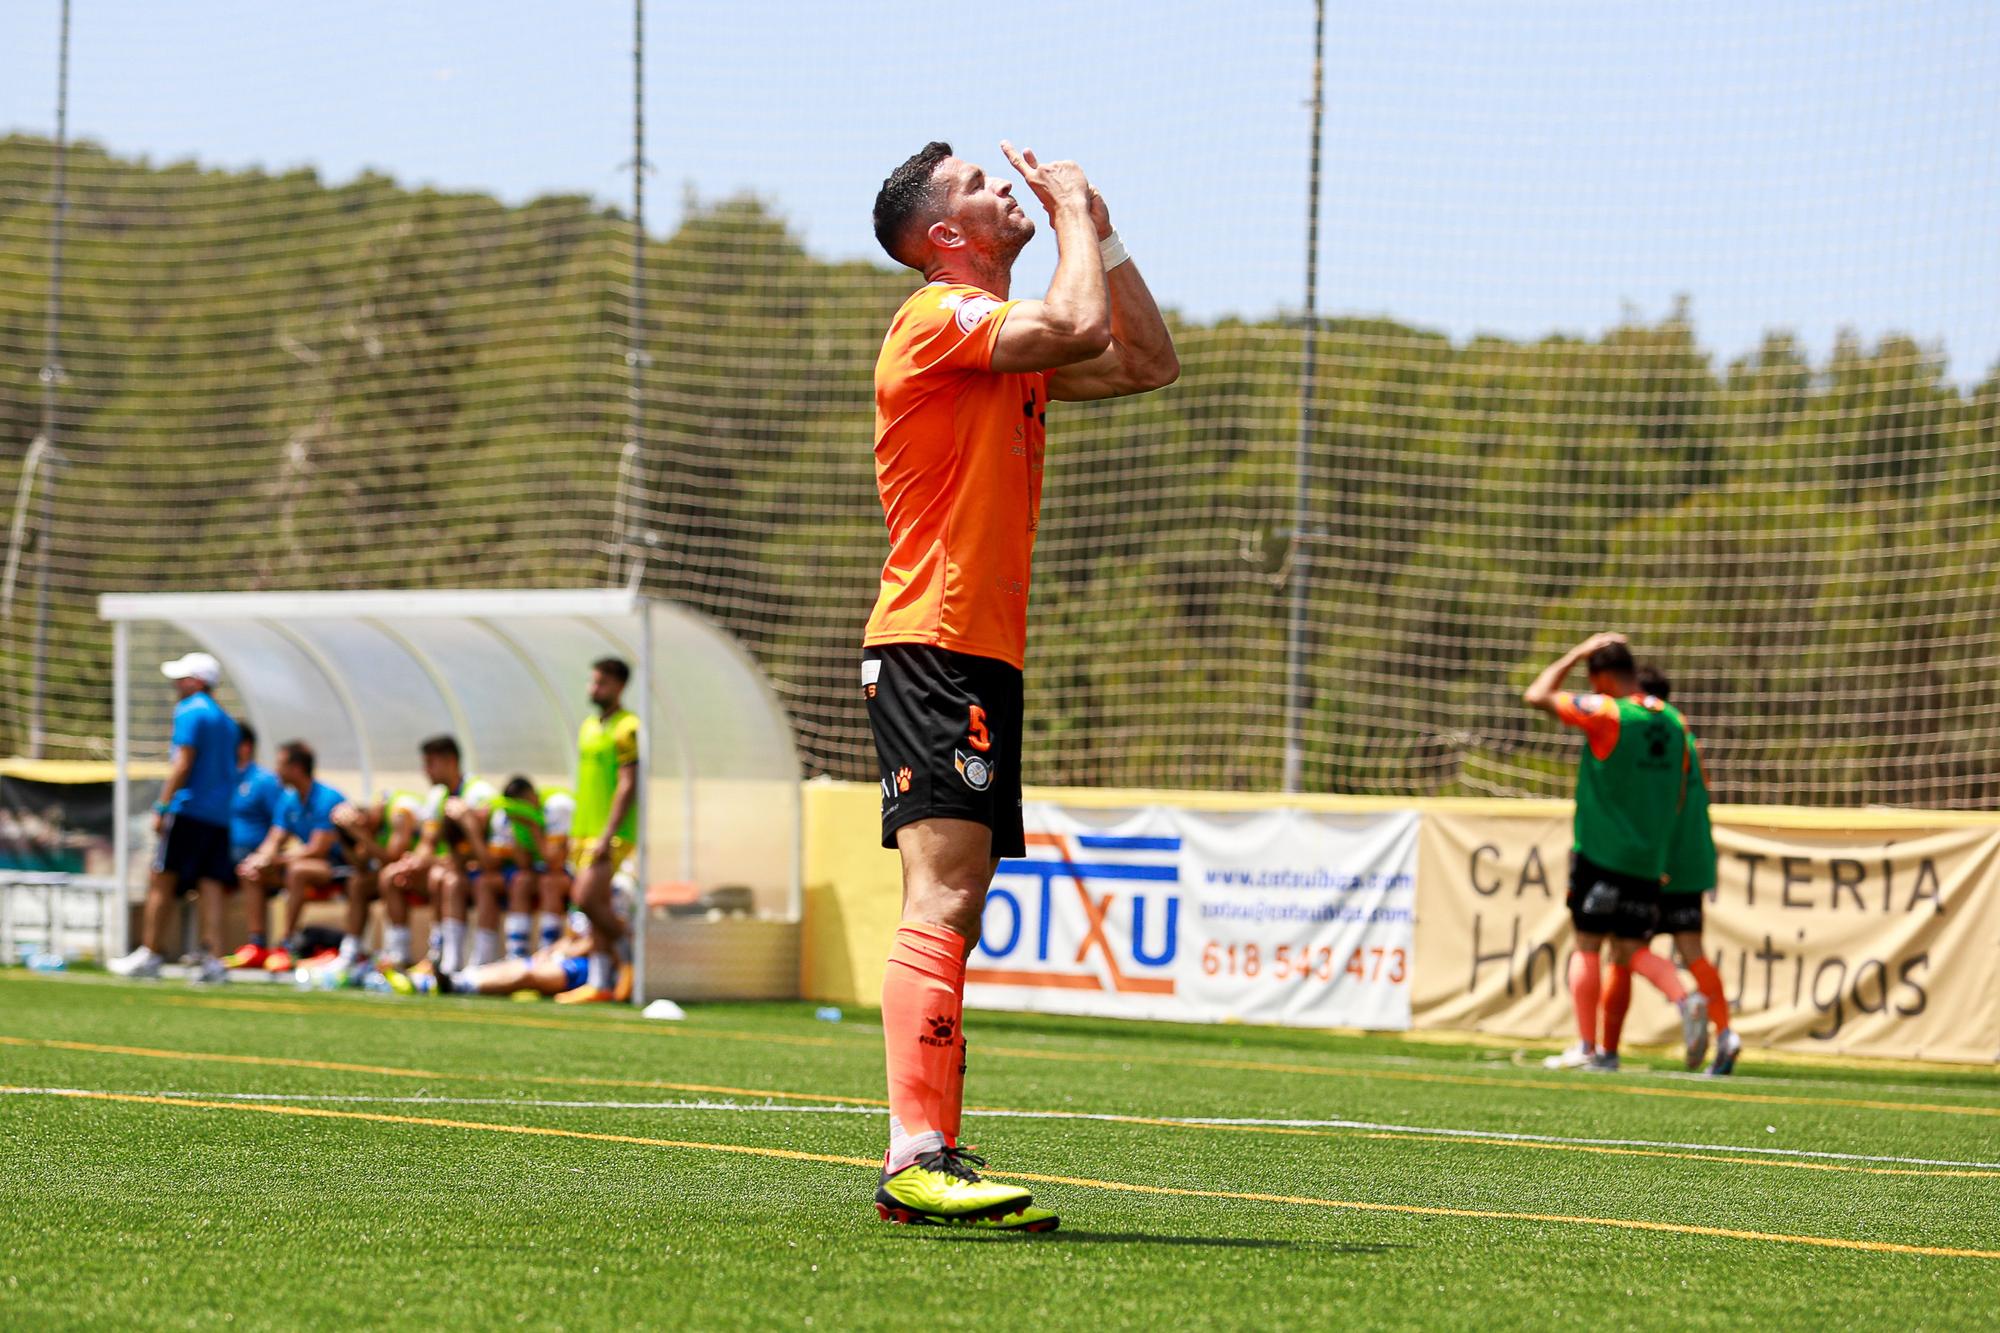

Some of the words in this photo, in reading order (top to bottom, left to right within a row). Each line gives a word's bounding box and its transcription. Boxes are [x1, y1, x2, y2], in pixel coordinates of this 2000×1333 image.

[968, 704, 991, 752] 5
[979, 860, 1179, 966] OTXU
[1470, 841, 1943, 914] CATERÍA
[1201, 940, 1262, 977] 618
[1274, 944, 1332, 980] 543
[1345, 946, 1407, 983] 473
[1671, 930, 1929, 1040] utigas
